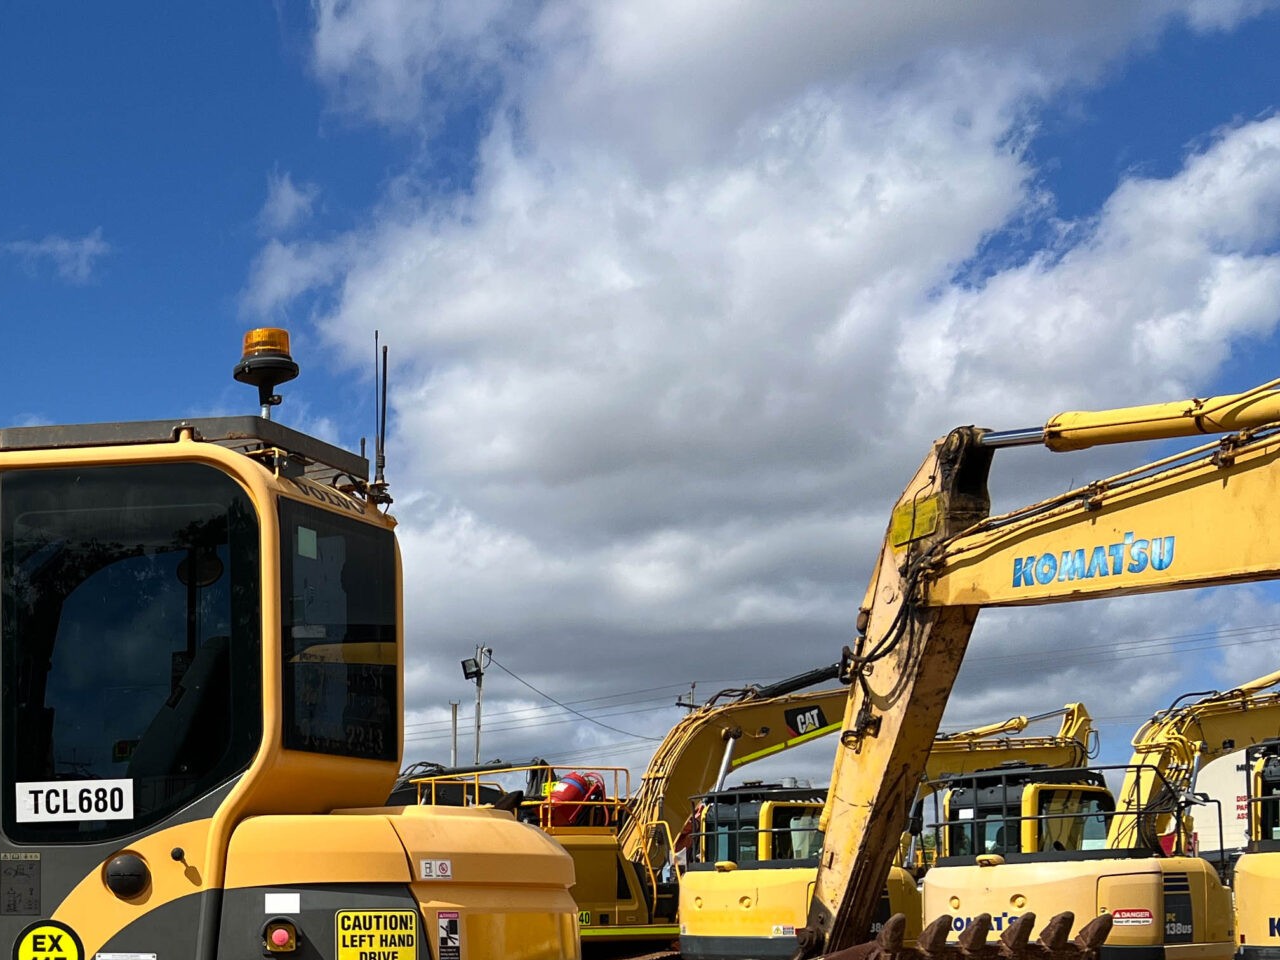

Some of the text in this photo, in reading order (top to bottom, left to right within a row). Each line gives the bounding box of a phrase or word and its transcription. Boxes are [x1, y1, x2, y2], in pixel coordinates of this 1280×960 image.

[296, 481, 365, 515] VOLVO
[1012, 531, 1175, 587] KOMATSU
[796, 709, 820, 734] CAT
[29, 787, 124, 815] TCL680
[341, 915, 413, 931] CAUTION!
[32, 934, 63, 952] EX
[342, 934, 414, 948] LEFT HAND
